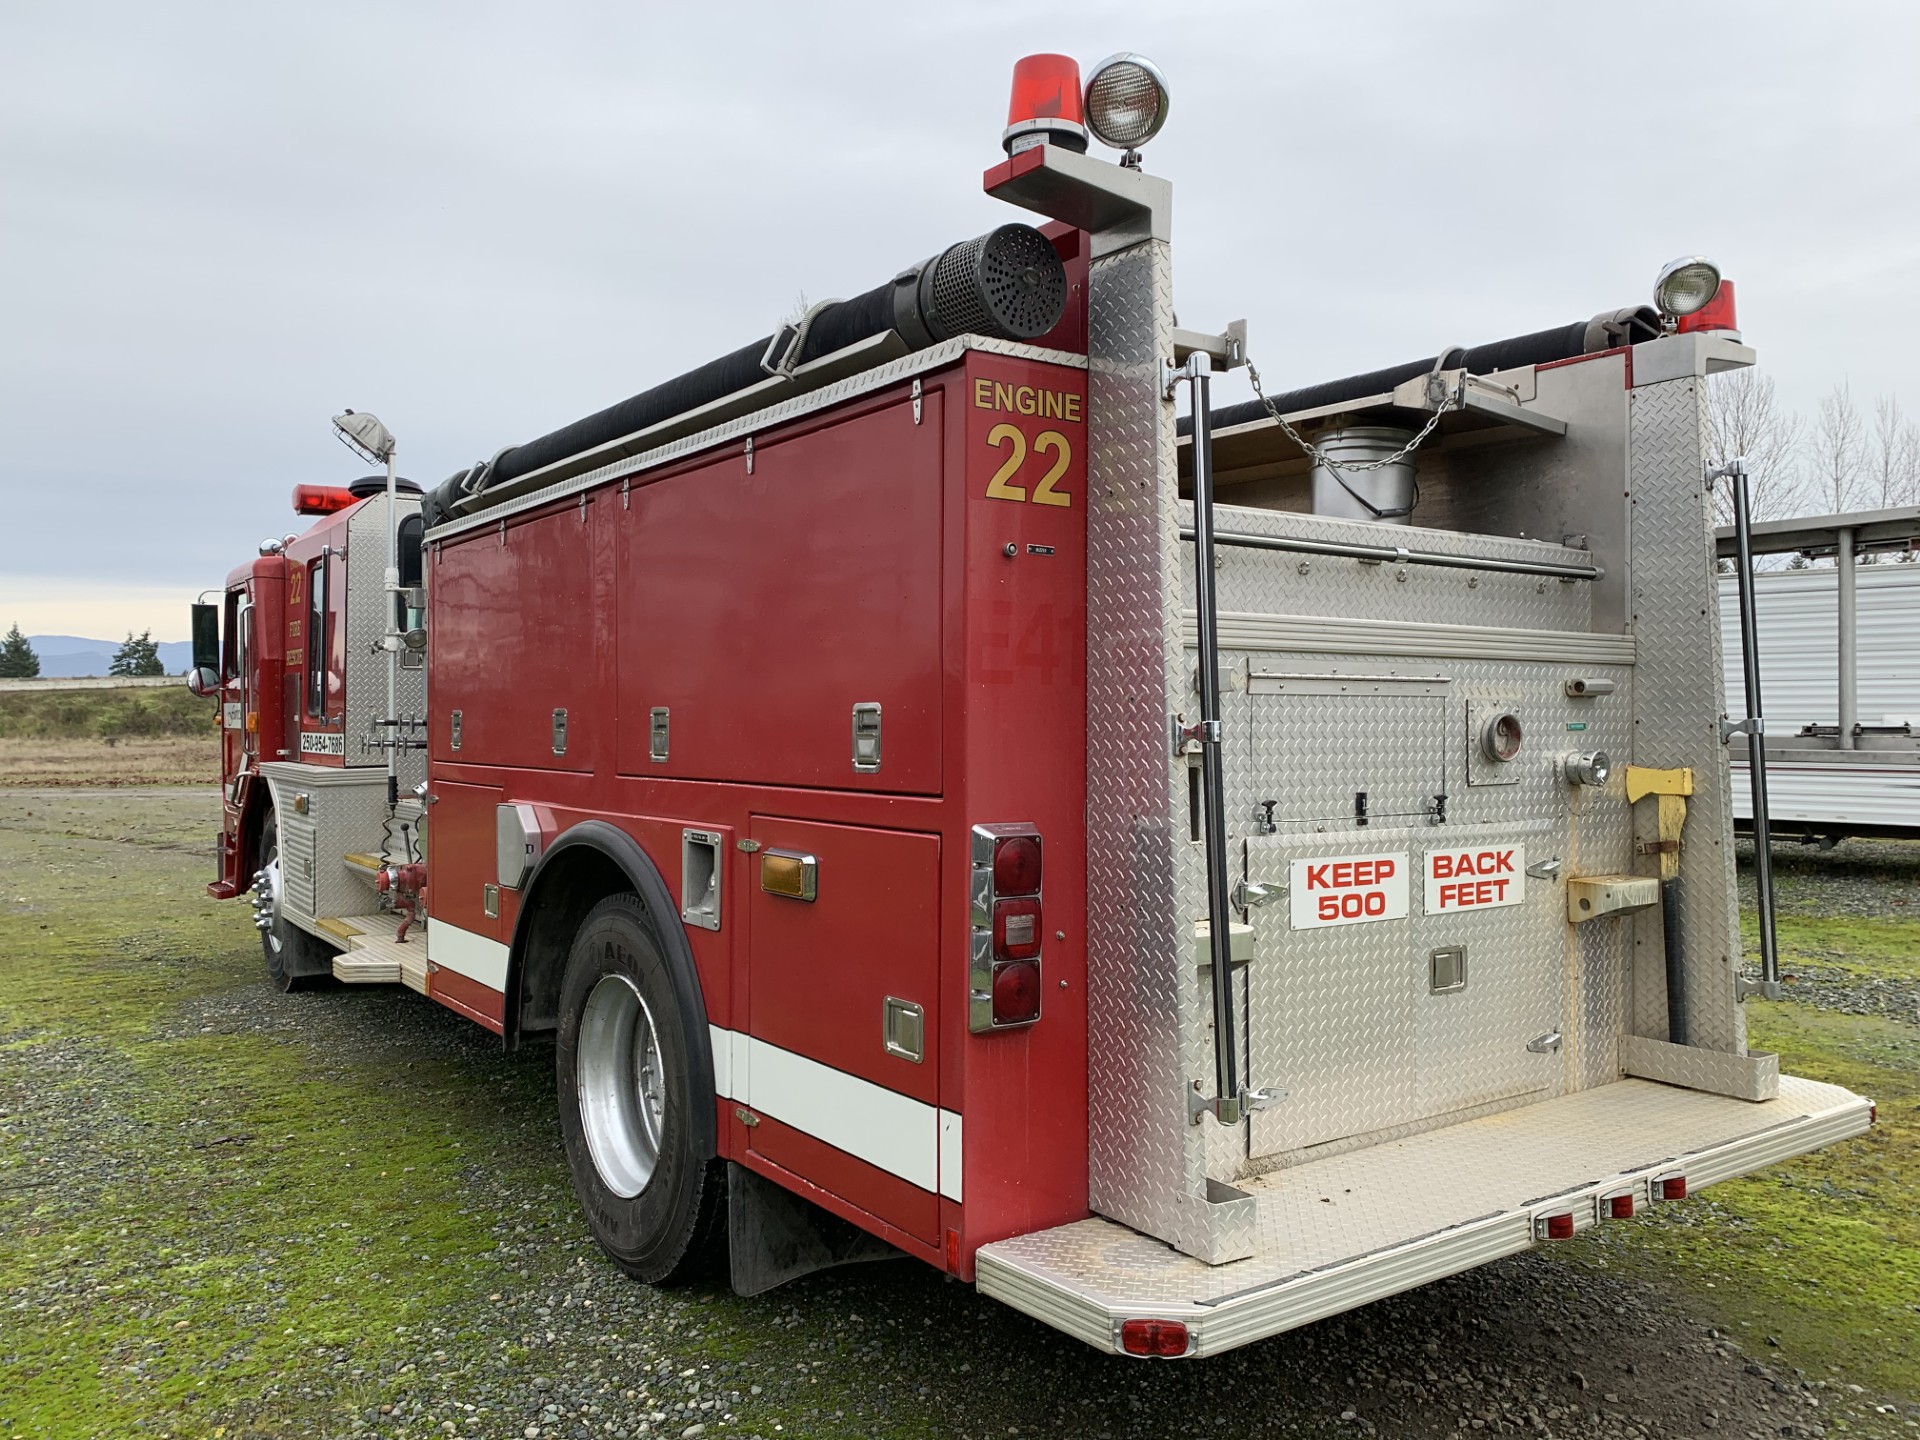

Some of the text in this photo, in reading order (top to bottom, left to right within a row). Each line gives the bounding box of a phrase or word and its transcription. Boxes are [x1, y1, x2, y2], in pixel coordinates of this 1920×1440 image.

[974, 377, 1082, 423] ENGINE
[985, 423, 1072, 508] 22
[289, 572, 302, 605] 22
[303, 734, 342, 753] 250-954-7686
[1307, 860, 1395, 890] KEEP
[1433, 850, 1515, 879] BACK
[1318, 891, 1386, 921] 500
[1440, 879, 1509, 909] FEET
